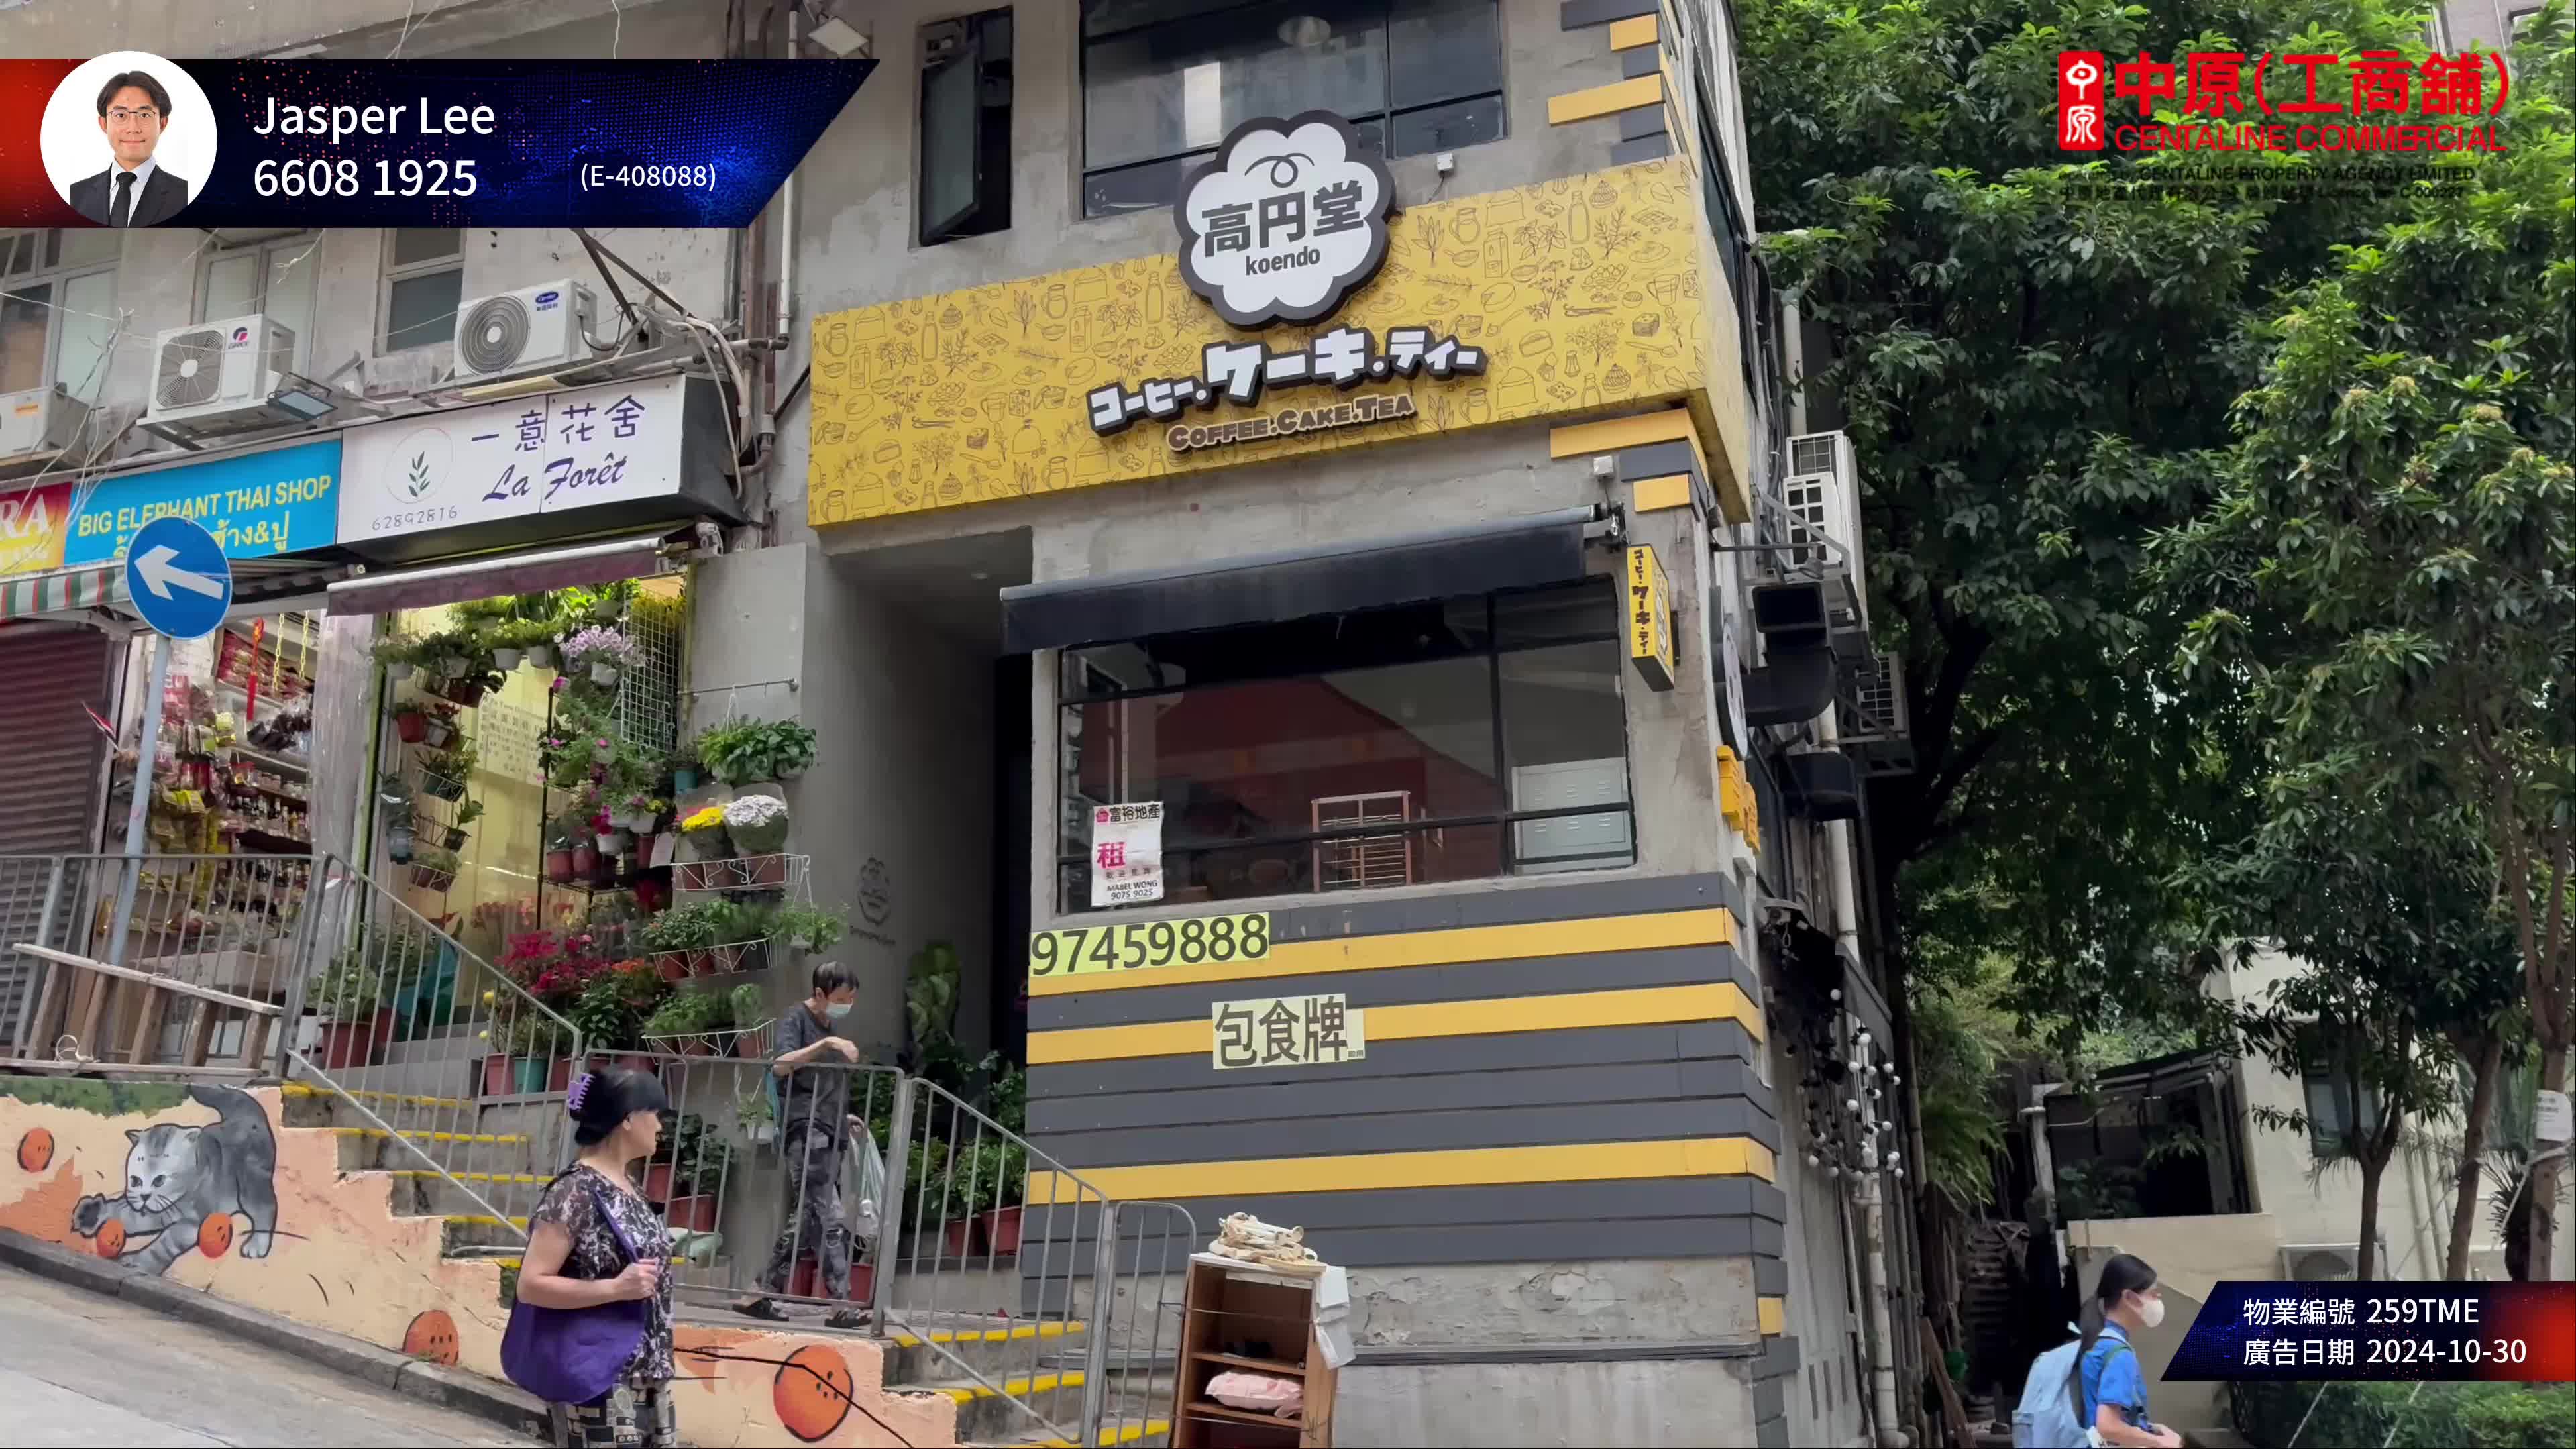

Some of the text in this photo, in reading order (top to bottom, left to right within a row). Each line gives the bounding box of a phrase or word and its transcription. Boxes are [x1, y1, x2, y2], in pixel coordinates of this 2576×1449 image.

[1201, 179, 1366, 258] 高円堂
[1244, 245, 1321, 276] koendo
[472, 394, 645, 451] 一意花舍
[482, 451, 628, 502] La Forêt
[78, 511, 113, 537] BIG
[225, 484, 270, 515] THAI
[274, 474, 331, 506] SHOP
[371, 505, 458, 531] 62892816
[1109, 804, 1160, 822] 富裕地產
[1097, 841, 1126, 869] 租
[1110, 888, 1154, 900] 9075 9025
[1133, 879, 1158, 889] WONG
[1031, 914, 1269, 976] 97459888
[1214, 995, 1348, 1067] 包食牌
